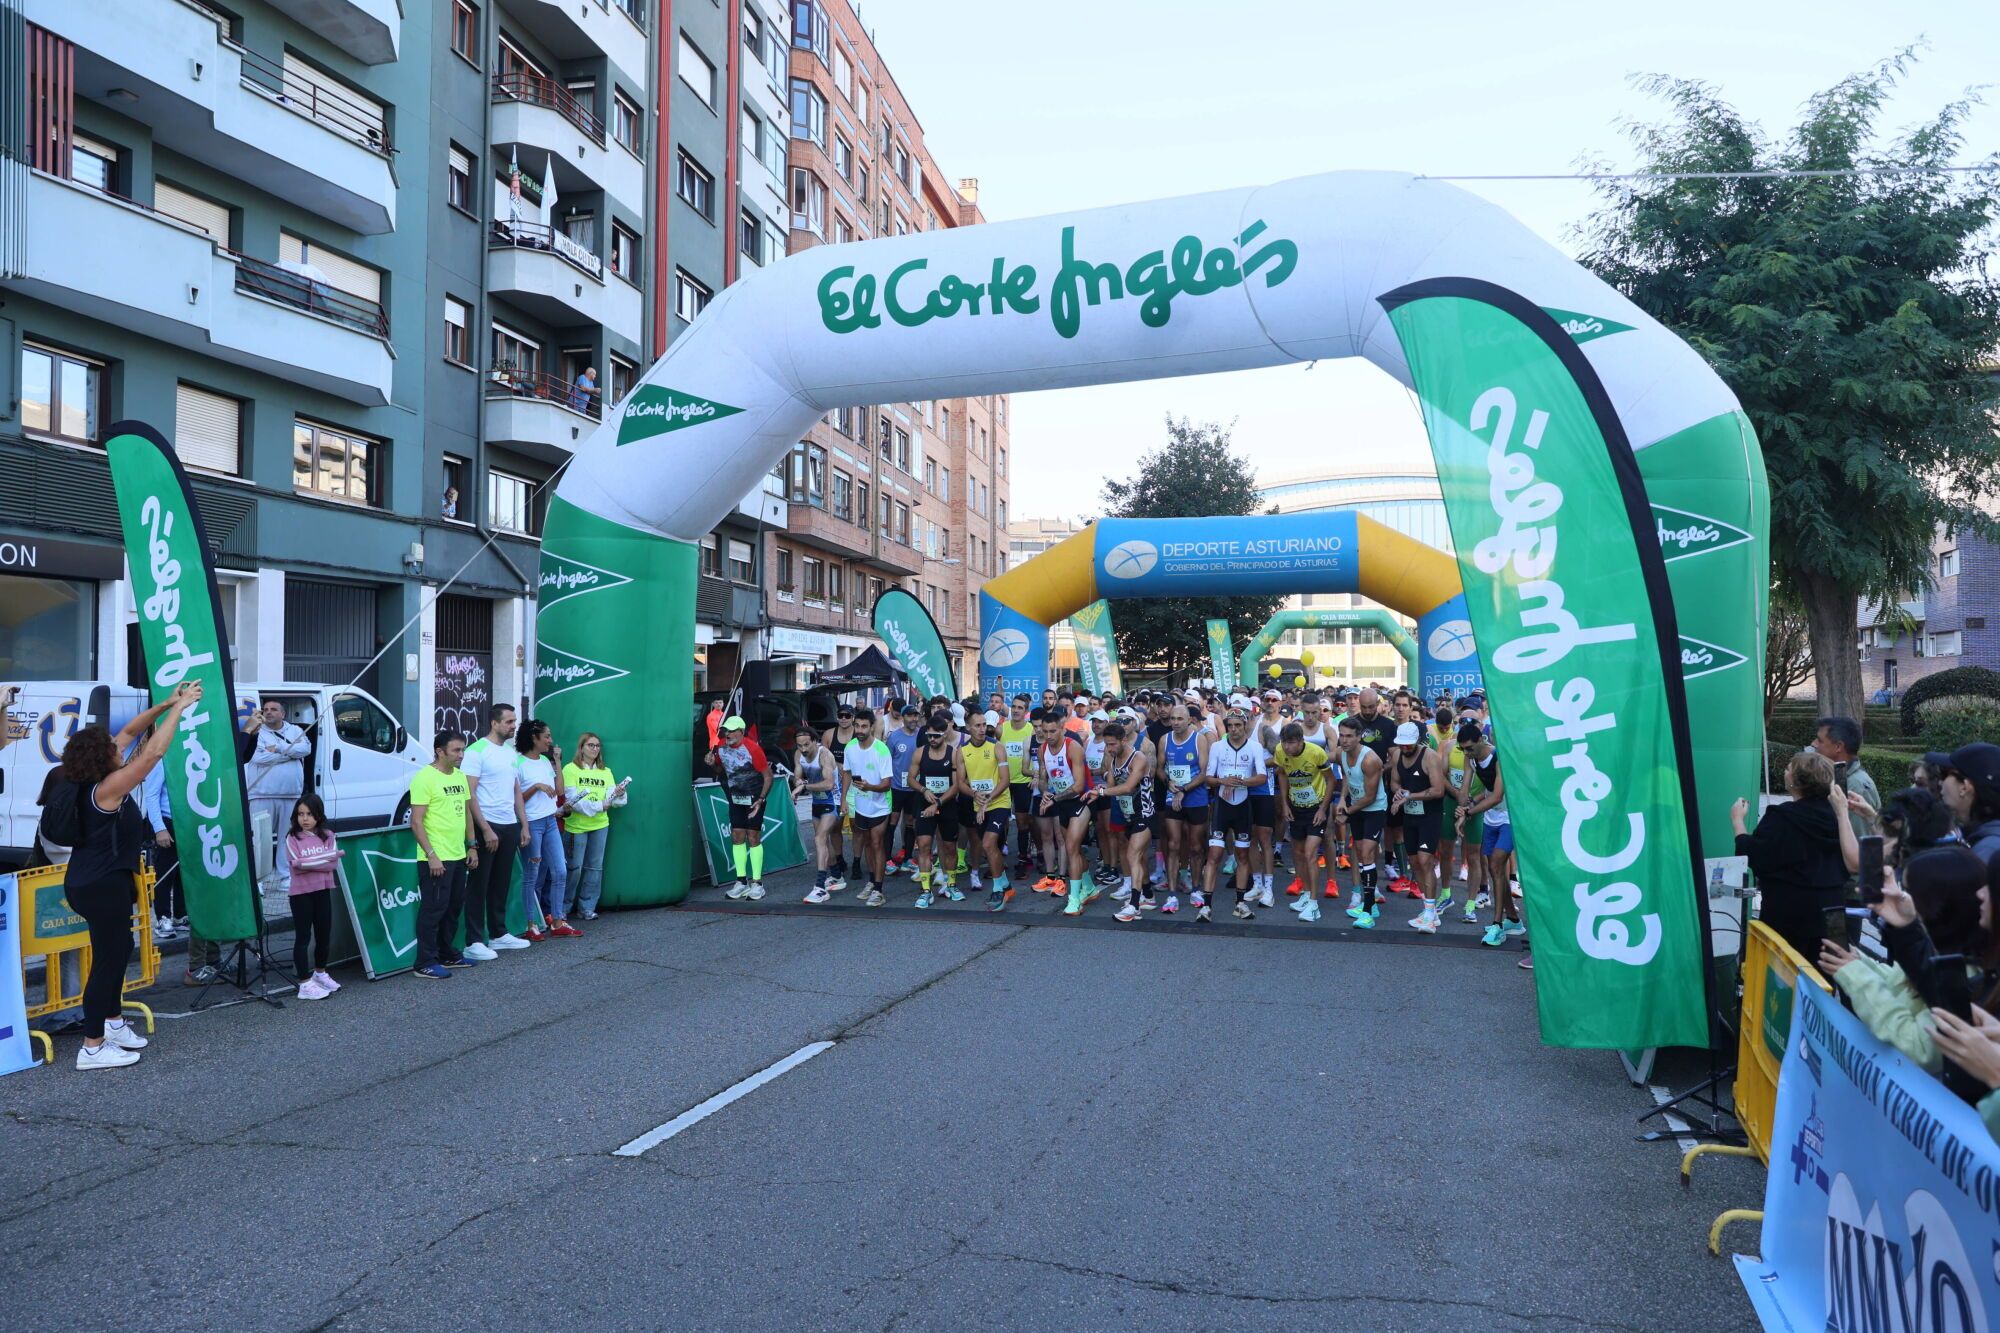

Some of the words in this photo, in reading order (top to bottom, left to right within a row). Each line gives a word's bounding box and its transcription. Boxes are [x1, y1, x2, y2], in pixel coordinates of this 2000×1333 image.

[817, 266, 881, 334] El
[884, 257, 1040, 327] Corte
[1050, 219, 1298, 339] Inglés
[626, 403, 636, 417] El
[636, 402, 665, 416] Corte
[665, 396, 715, 421] Inglés
[1163, 541, 1239, 557] DEPORTE
[1246, 537, 1341, 554] ASTURIANO
[556, 566, 599, 589] Inglés
[553, 659, 595, 682] Inglés
[1425, 673, 1483, 687] DEPORT
[1172, 769, 1185, 777] 387
[380, 888, 397, 910] El
[42, 918, 65, 929] CAJA
[1883, 1078, 1945, 1165] VERDE
[1942, 1133, 1975, 1197] DE
